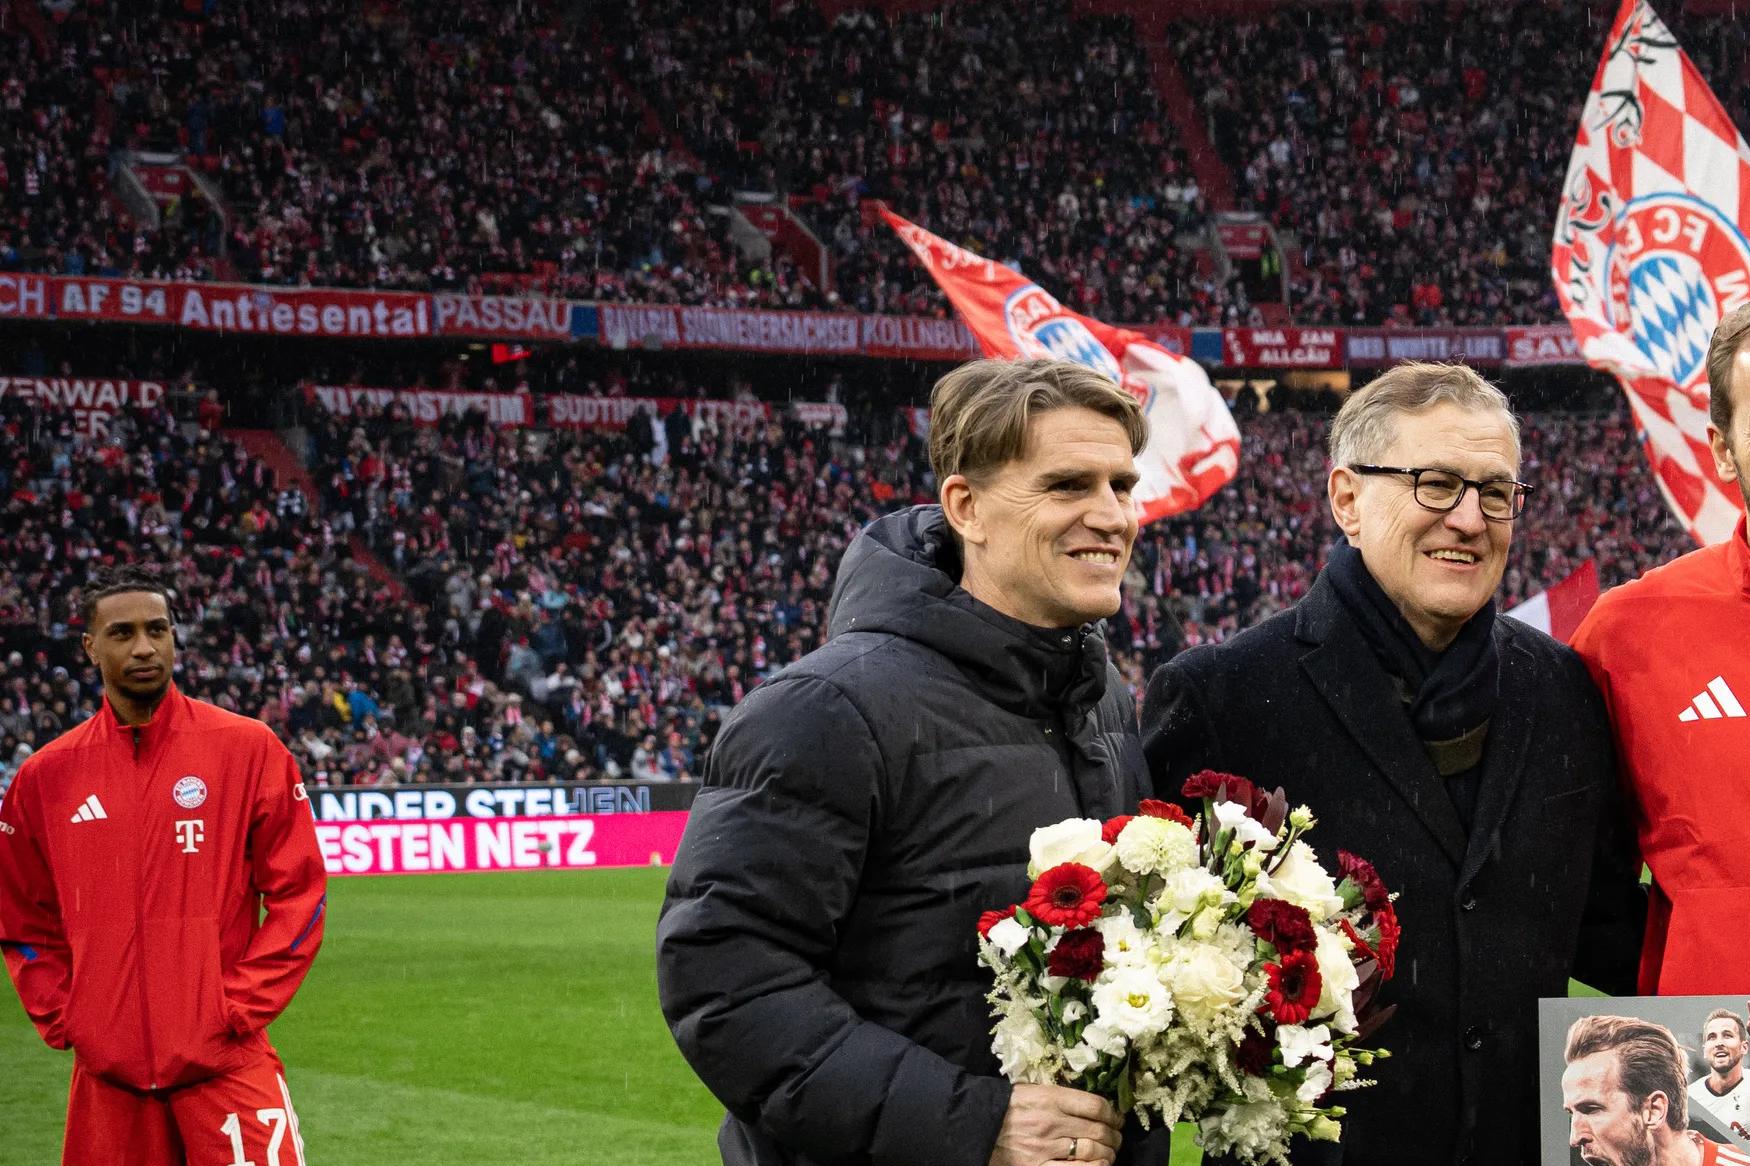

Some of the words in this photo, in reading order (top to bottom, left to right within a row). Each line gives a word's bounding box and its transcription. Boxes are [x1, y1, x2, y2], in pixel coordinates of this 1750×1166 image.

[62, 283, 109, 313] AF
[120, 286, 167, 316] 94
[436, 300, 572, 334] PASSAU
[311, 788, 457, 821] NDER
[175, 819, 205, 854] T
[475, 819, 597, 868] NETZ
